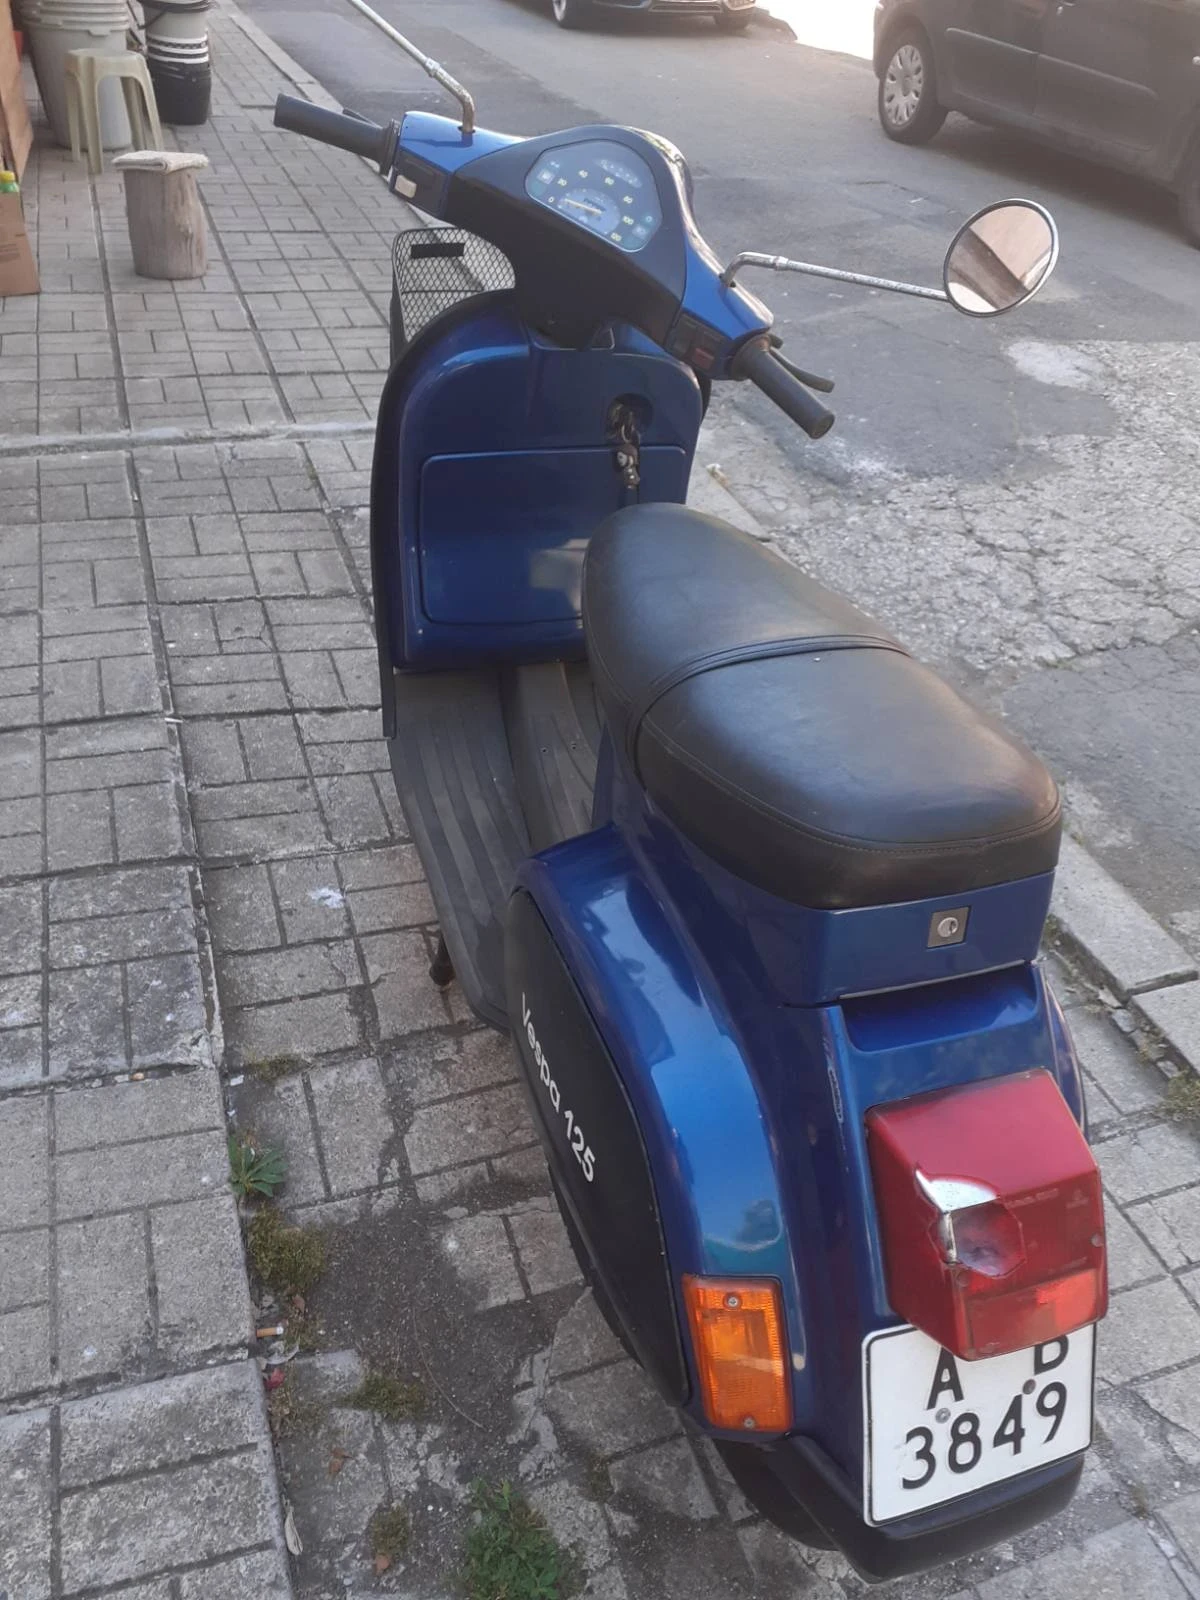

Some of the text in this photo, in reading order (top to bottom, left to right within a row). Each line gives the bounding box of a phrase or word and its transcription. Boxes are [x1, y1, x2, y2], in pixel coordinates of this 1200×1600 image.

[521, 992, 596, 1183] Vespa 125
[926, 1346, 965, 1411] A
[901, 1381, 1068, 1490] 3849
